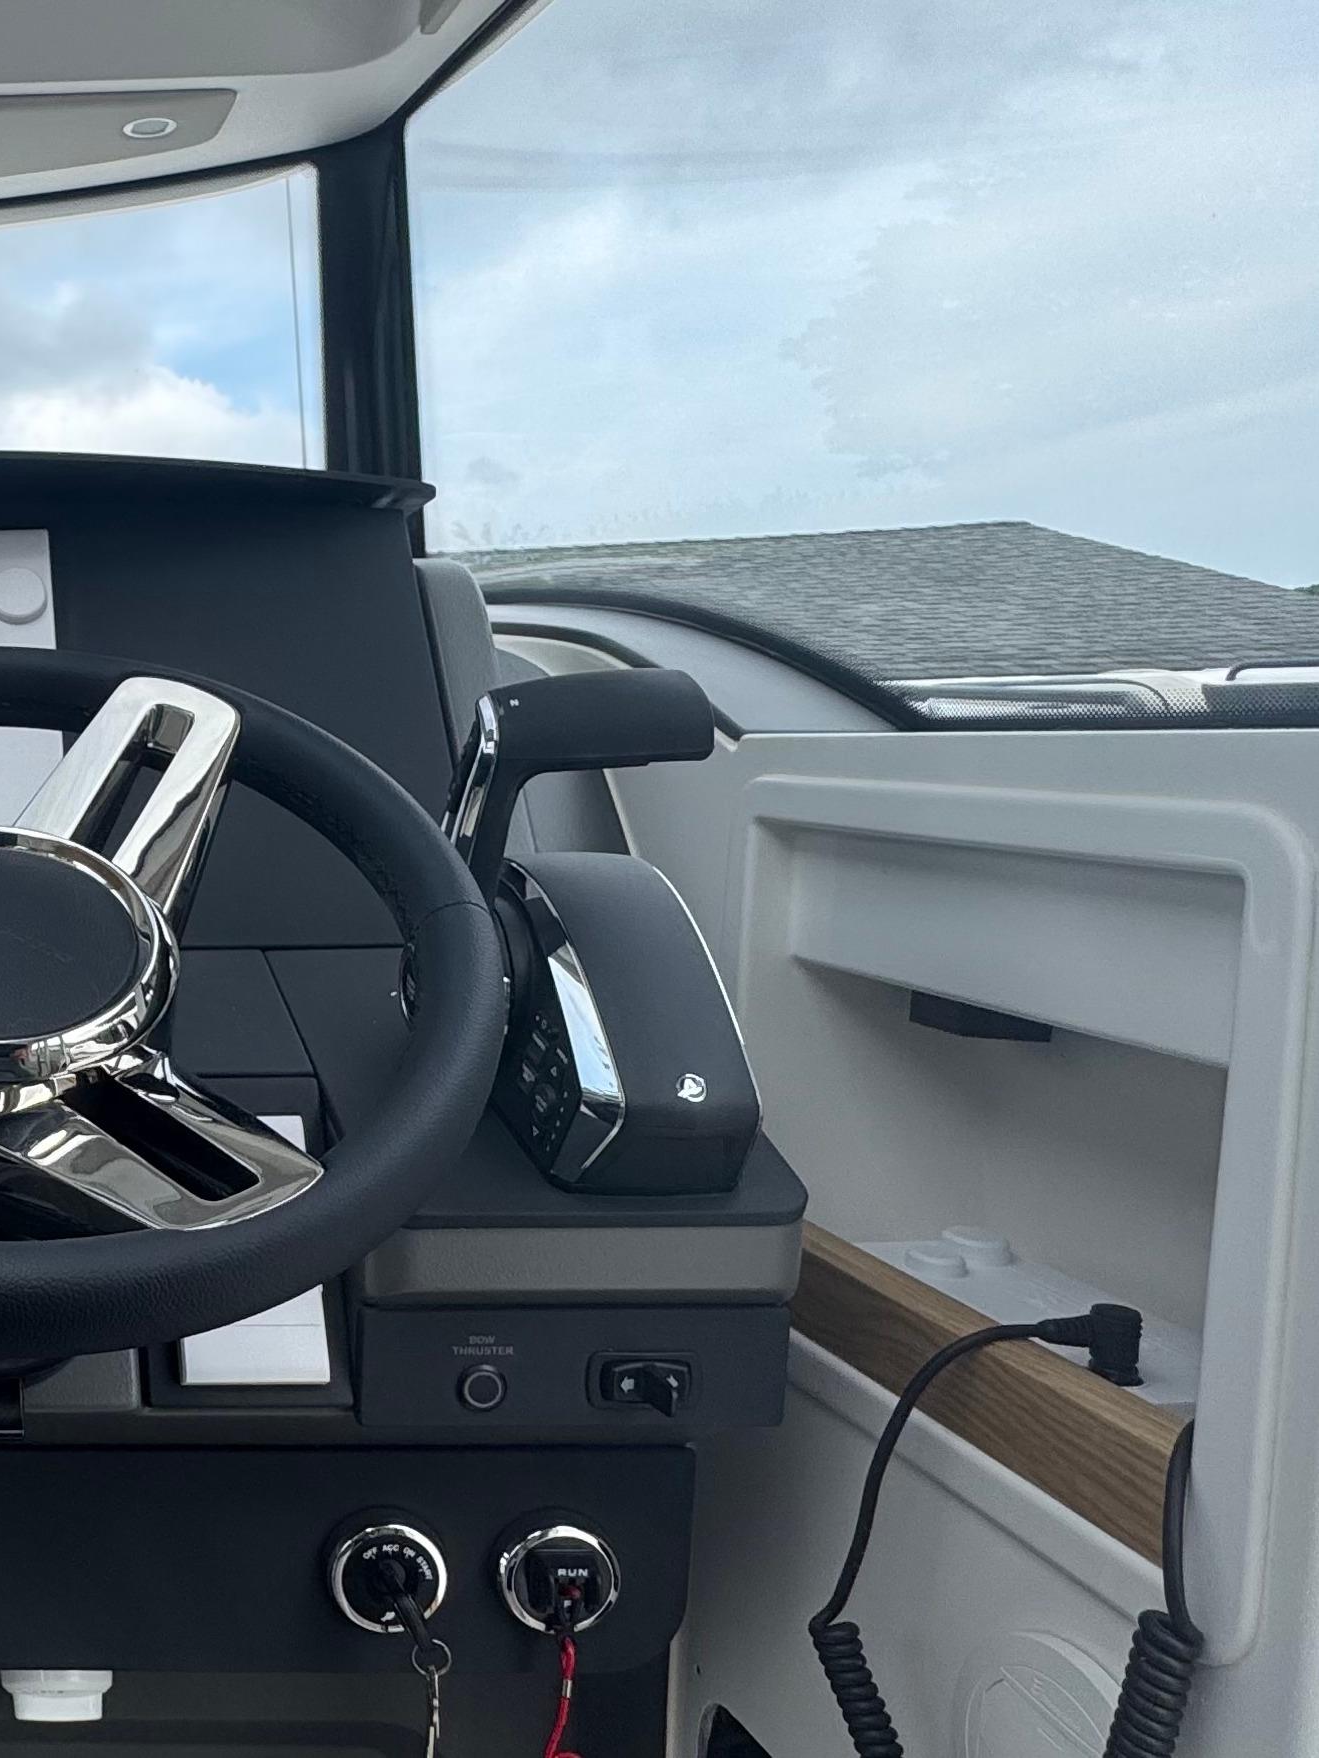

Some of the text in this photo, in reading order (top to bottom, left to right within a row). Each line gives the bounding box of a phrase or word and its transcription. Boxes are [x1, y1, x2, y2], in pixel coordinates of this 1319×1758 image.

[468, 1335, 496, 1345] BOW
[451, 1345, 514, 1356] THRUSTER
[362, 1543, 434, 1581] OFF ACC ON START
[556, 1567, 589, 1577] RUN
